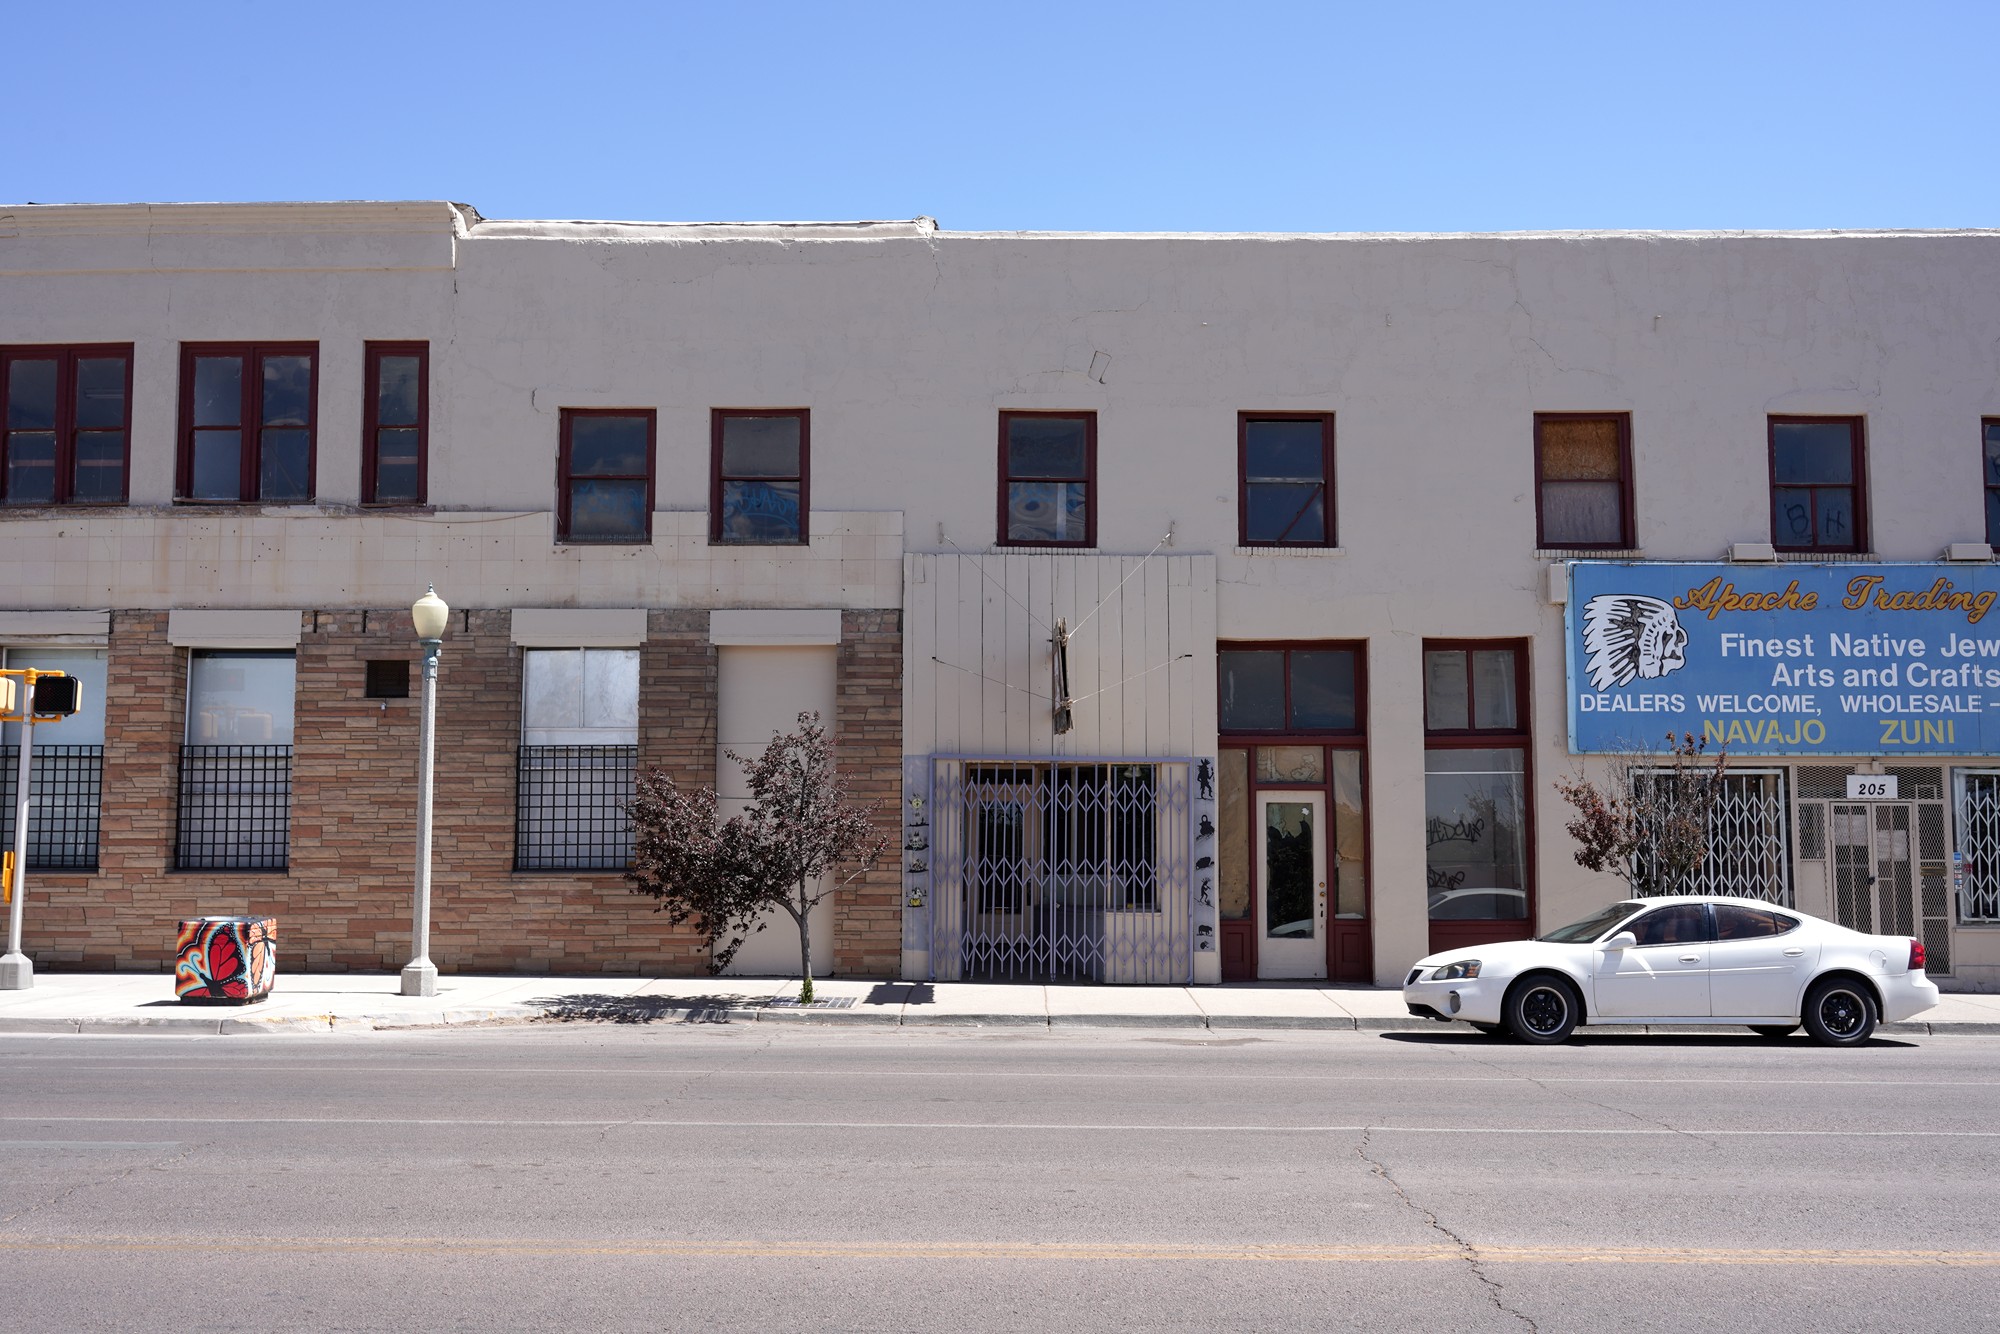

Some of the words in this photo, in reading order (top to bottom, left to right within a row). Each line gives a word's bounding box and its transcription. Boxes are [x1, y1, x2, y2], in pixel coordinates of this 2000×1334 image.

[1673, 576, 1818, 620] Apache
[1842, 575, 1998, 624] Trading
[1721, 633, 1815, 657] Finest
[1830, 633, 1926, 657] Native
[1940, 633, 2000, 658] Jew
[1771, 662, 1835, 688] Arts
[1842, 662, 1898, 687] and
[1906, 662, 2000, 688] Crafts
[1580, 693, 1686, 713] DEALERS
[1696, 694, 1822, 717] WELCOME,
[1840, 694, 1983, 713] WHOLESALE
[1704, 719, 1826, 745] NAVAJO
[1880, 719, 1955, 744] ZUNI
[1857, 782, 1887, 796] 205
